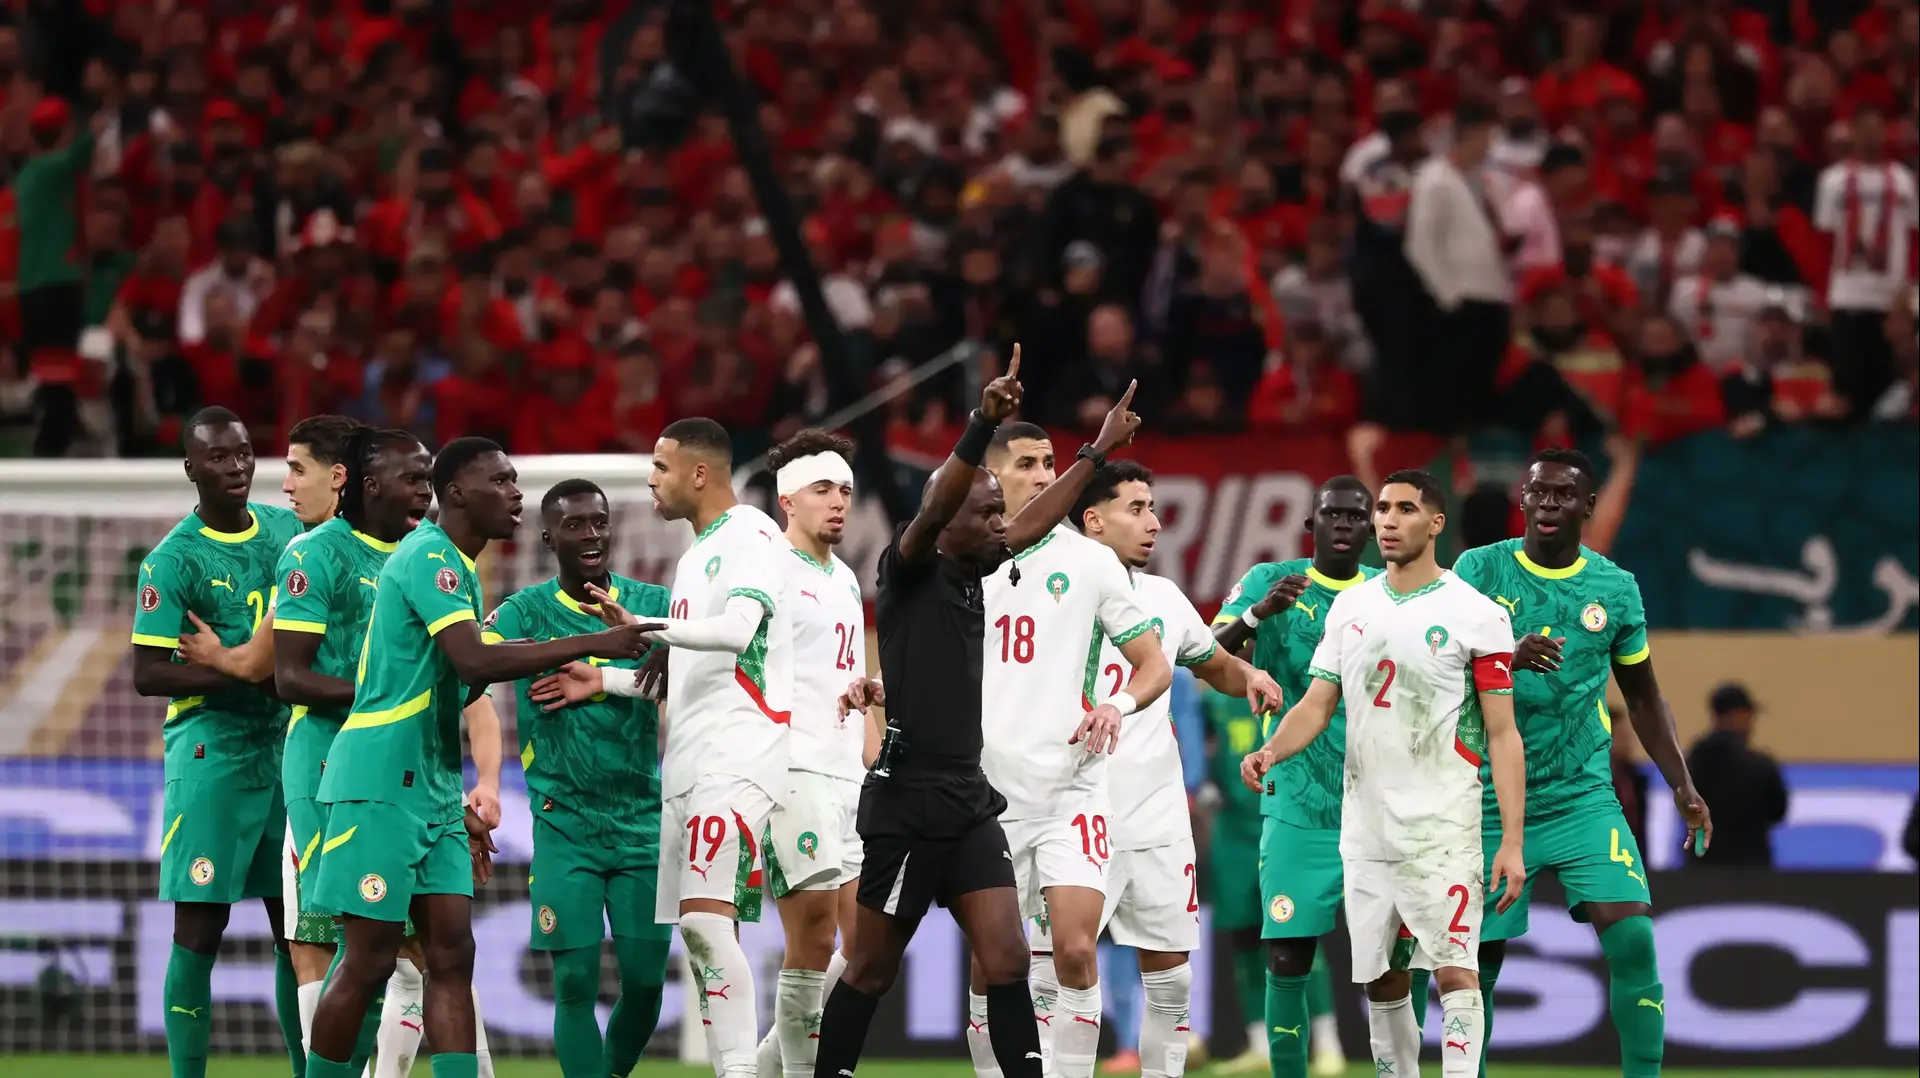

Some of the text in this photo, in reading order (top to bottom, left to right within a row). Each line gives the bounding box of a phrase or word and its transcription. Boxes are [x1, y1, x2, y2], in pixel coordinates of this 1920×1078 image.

[246, 585, 278, 636] 2
[835, 622, 855, 671] 24
[994, 614, 1035, 664] 18
[1104, 663, 1139, 698] 2
[1373, 659, 1396, 708] 2
[686, 815, 726, 862] 19
[1071, 813, 1109, 860] 18
[1609, 828, 1634, 867] 4
[1184, 863, 1198, 913] 2
[1447, 884, 1470, 932] 2
